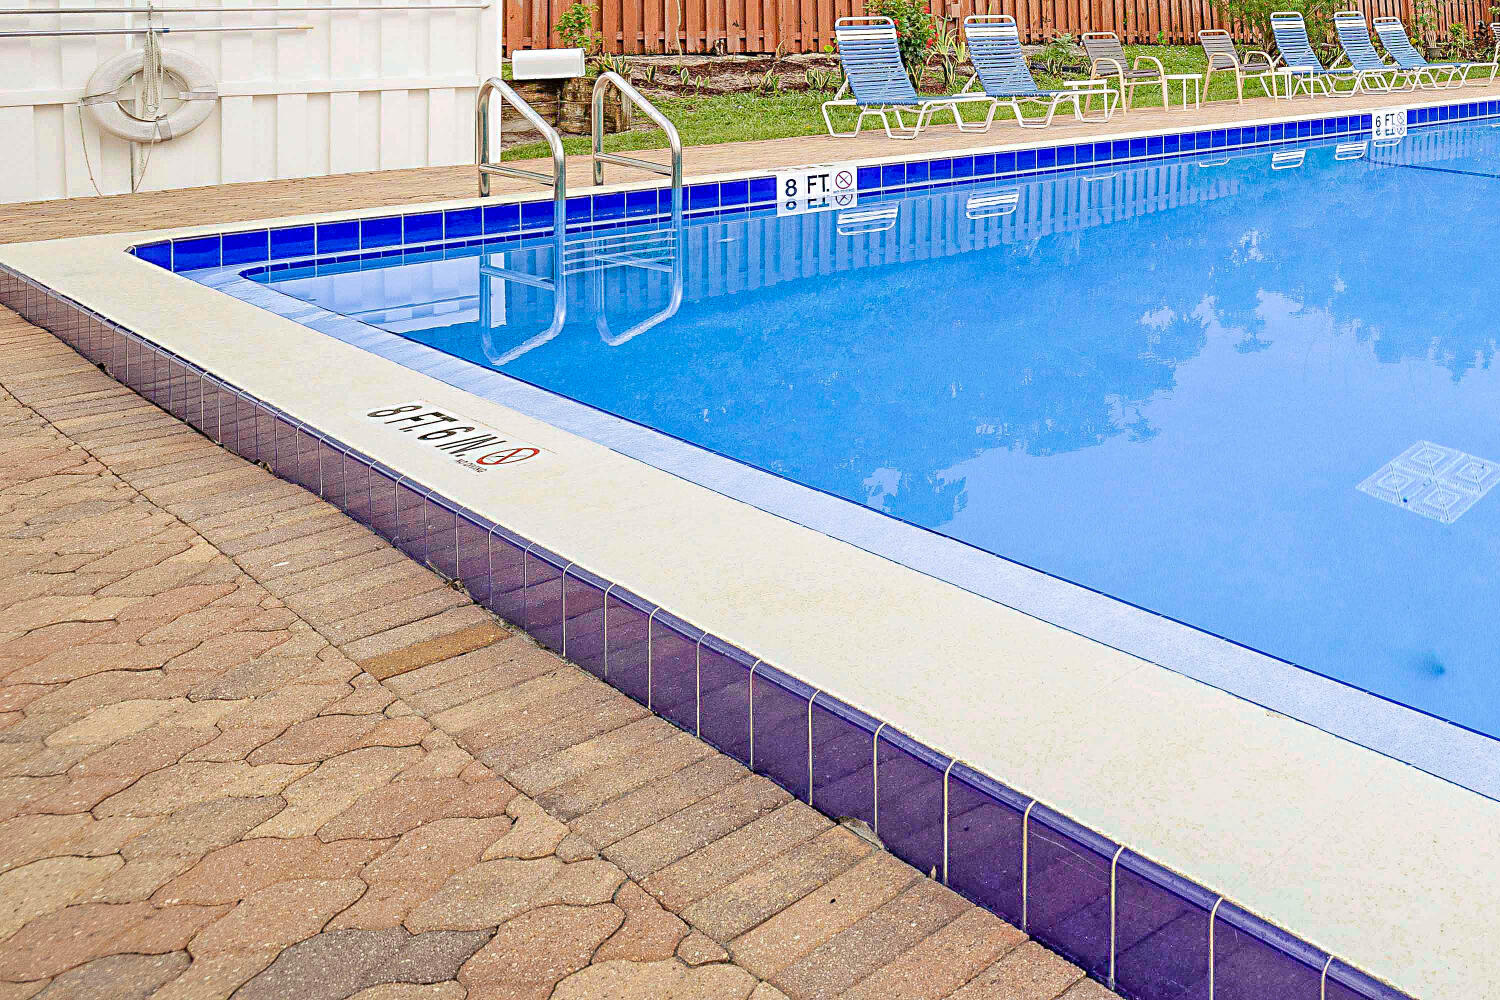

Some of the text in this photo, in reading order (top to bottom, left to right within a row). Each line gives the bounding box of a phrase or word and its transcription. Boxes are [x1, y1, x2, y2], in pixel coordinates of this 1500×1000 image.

[1375, 115, 1382, 128] 6
[785, 173, 830, 197] 8 FT.
[367, 405, 508, 458] 8 FT. 6 IN.
